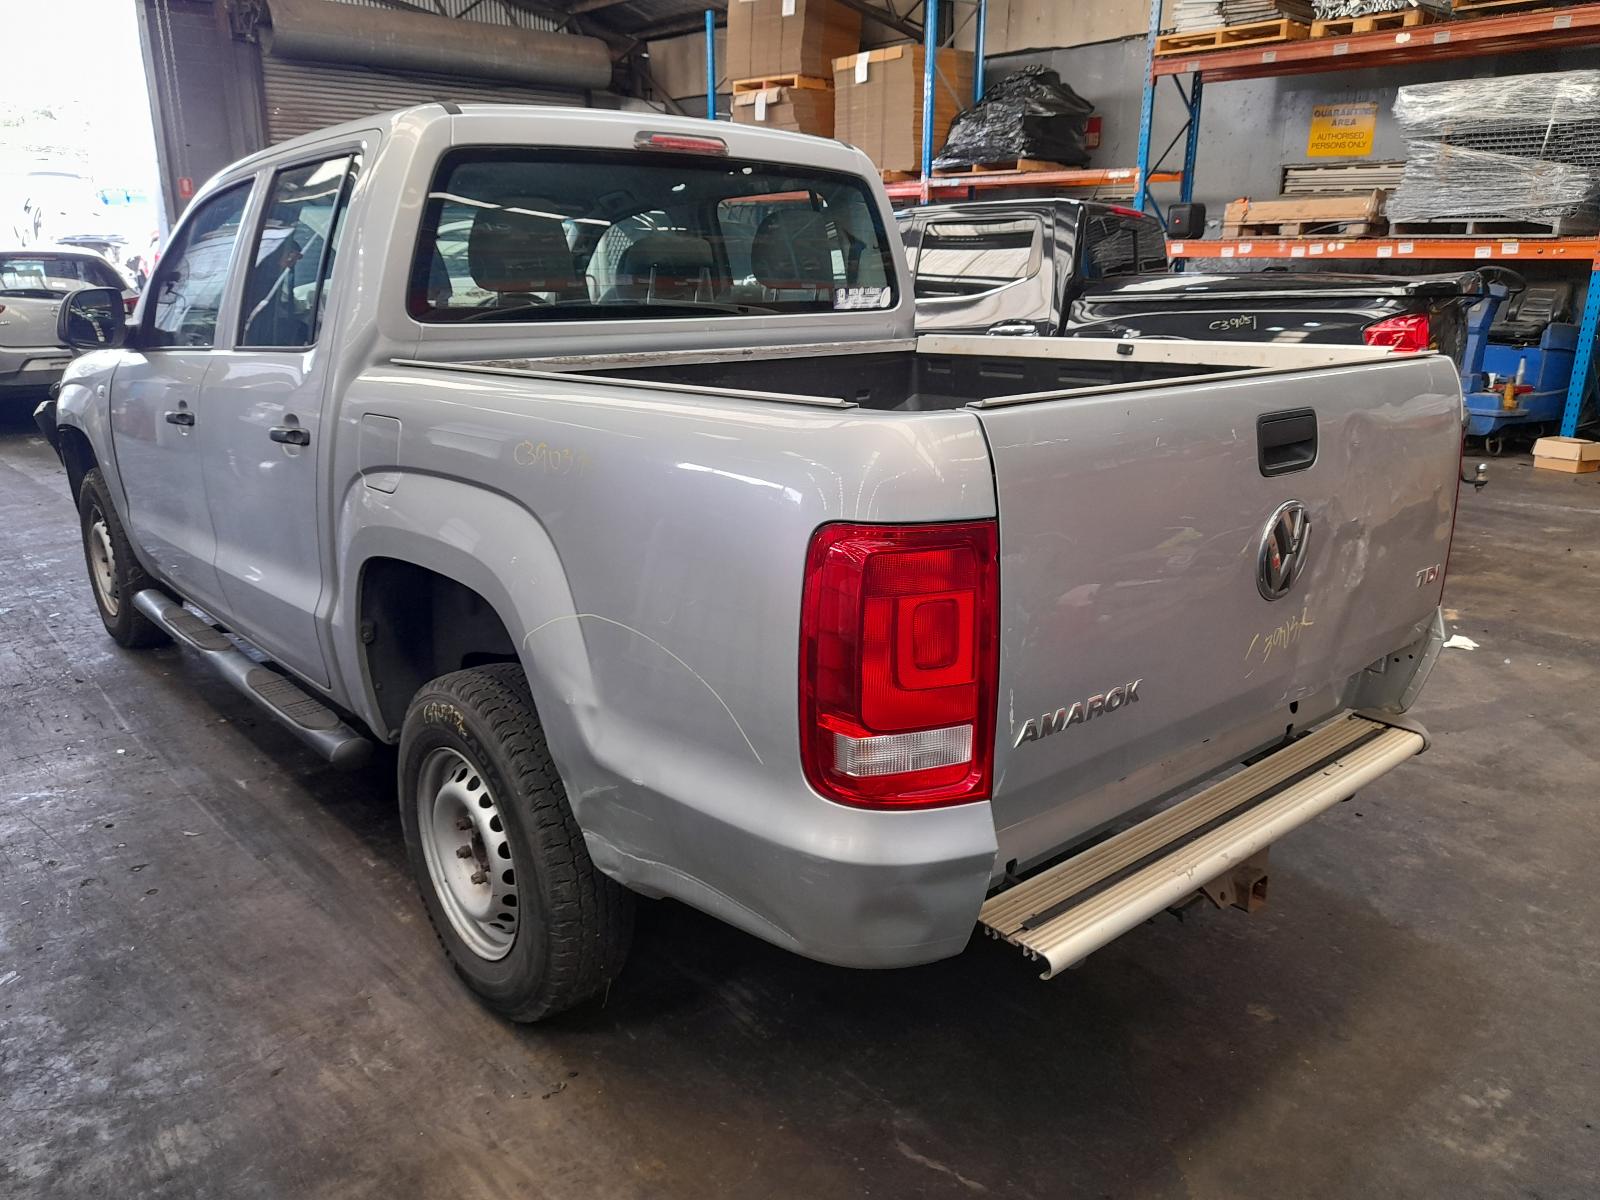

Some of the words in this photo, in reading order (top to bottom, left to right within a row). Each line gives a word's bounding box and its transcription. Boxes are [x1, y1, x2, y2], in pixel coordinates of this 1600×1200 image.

[1331, 118, 1356, 126] AREA
[1317, 131, 1365, 141] AUTHORISED
[1311, 141, 1346, 150] PERSONS
[1347, 141, 1367, 149] ONLY
[1416, 563, 1441, 588] TDI
[1013, 678, 1143, 749] AMAROK
